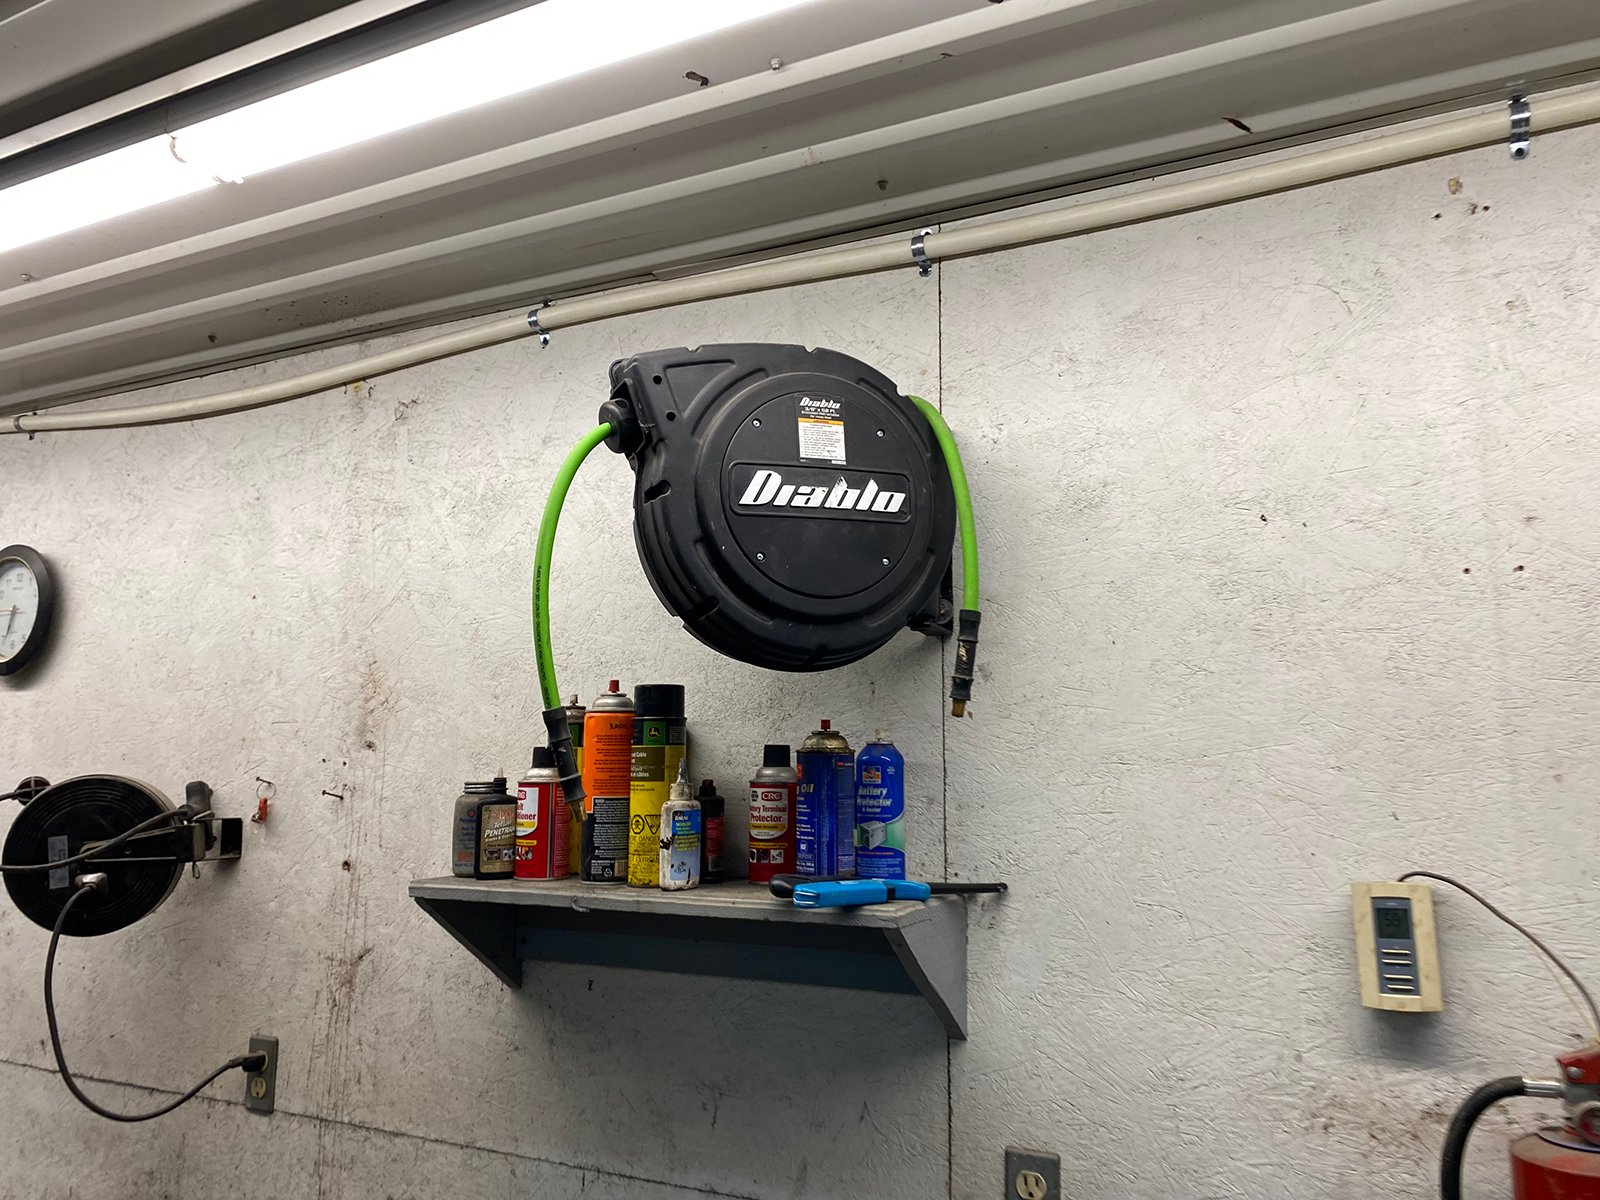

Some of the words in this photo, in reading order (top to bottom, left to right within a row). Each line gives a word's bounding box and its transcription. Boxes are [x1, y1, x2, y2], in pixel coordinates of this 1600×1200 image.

[799, 397, 841, 409] Diablo
[738, 470, 906, 513] Diablo
[762, 792, 782, 800] CRC
[762, 804, 787, 813] Terminal
[751, 813, 783, 823] Protector
